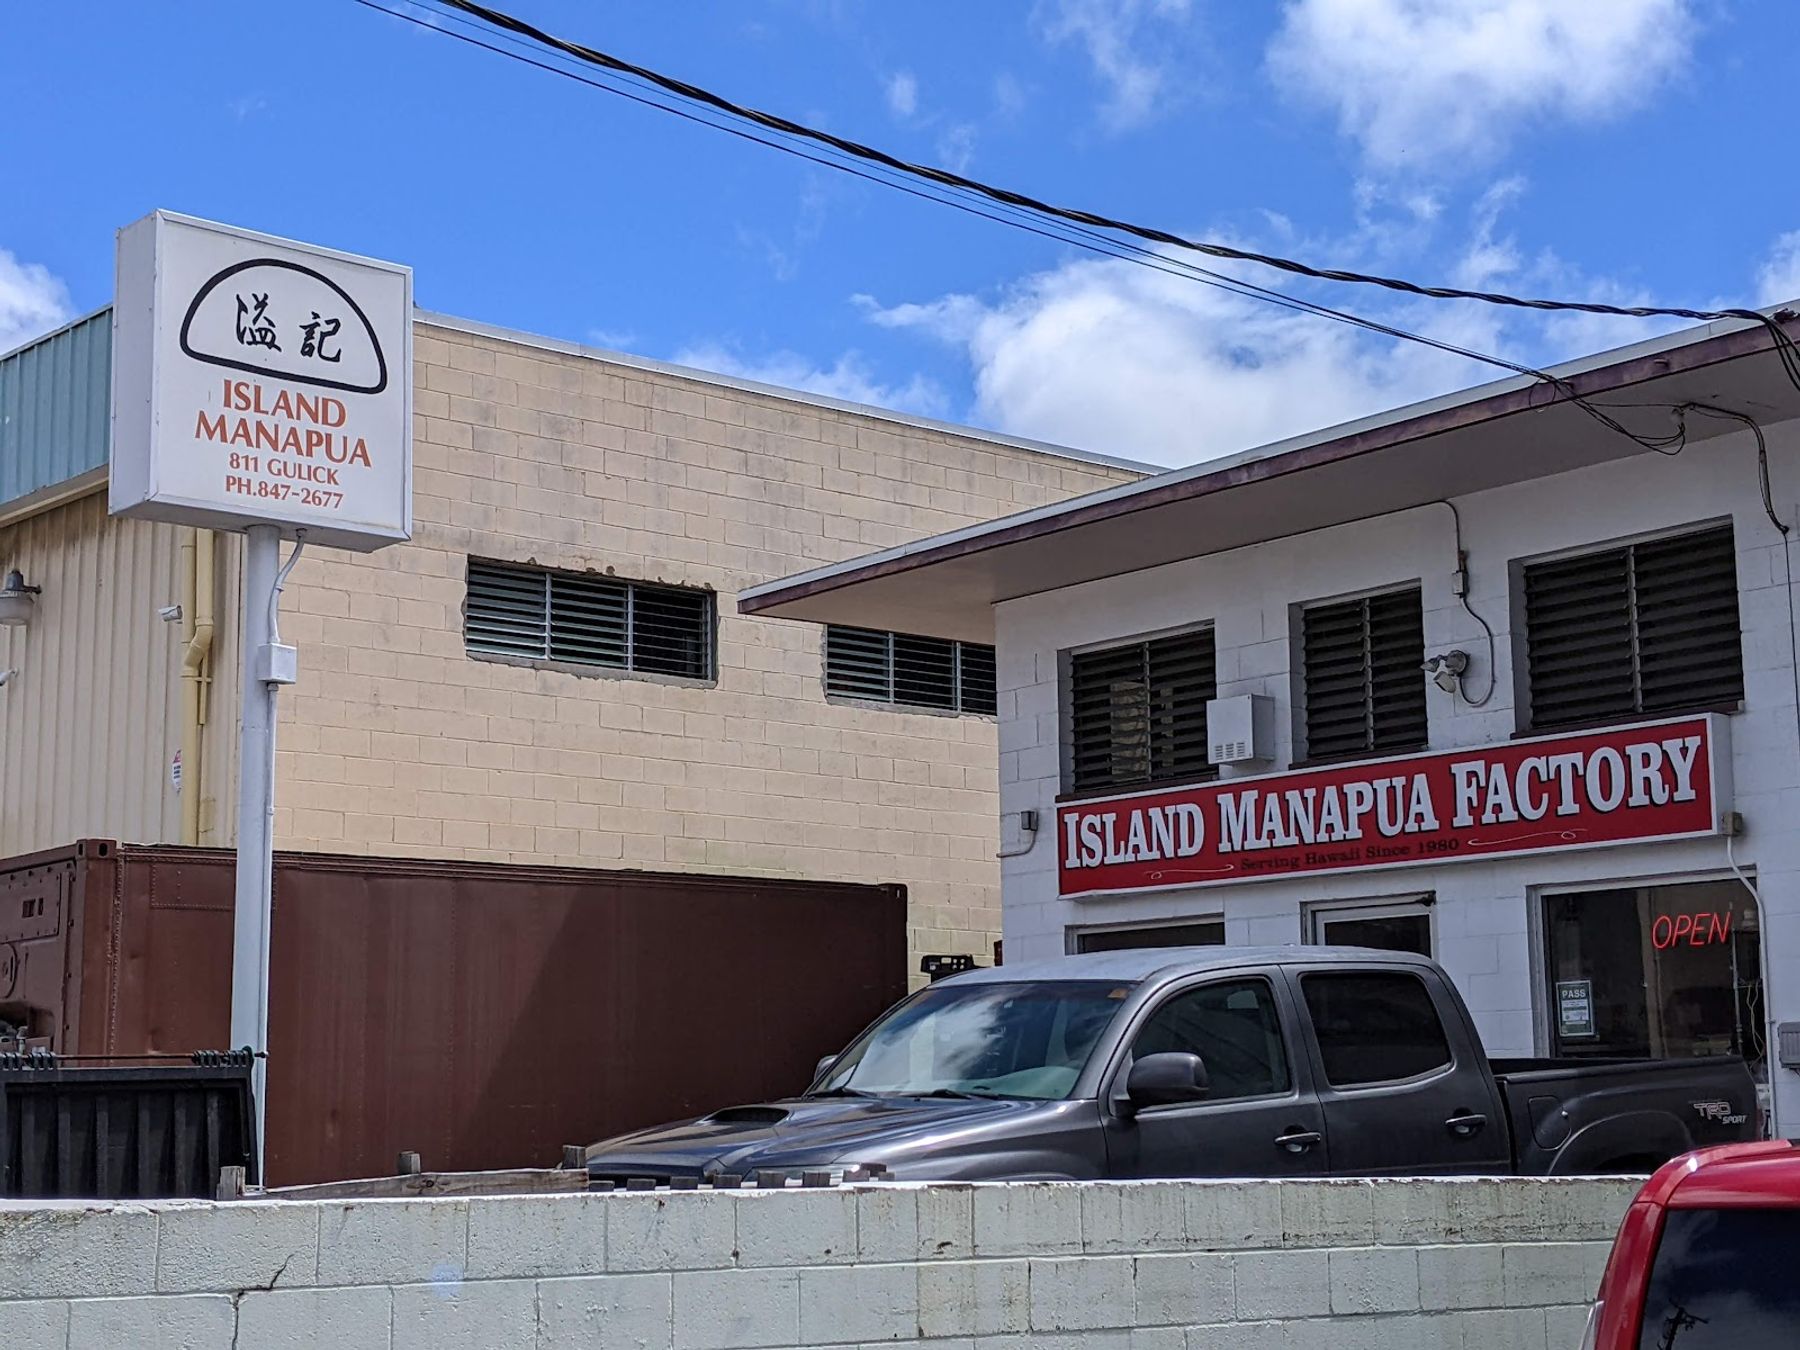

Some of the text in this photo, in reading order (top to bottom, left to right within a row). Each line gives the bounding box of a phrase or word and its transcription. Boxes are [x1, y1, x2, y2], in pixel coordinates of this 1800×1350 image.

[223, 379, 347, 428] ISLAND
[195, 410, 372, 468] MANAPUA
[229, 452, 340, 486] 811 GULICK
[225, 475, 343, 509] PH.847-2677
[1064, 735, 1701, 869] ISLAND MANAPUA FACTORY
[1241, 838, 1459, 871] Serving Hawaii Since 1980
[1652, 911, 1733, 949] OPEN
[1561, 989, 1586, 999] PASS
[1693, 1101, 1731, 1120] TRD
[1722, 1115, 1747, 1125] SPORT
